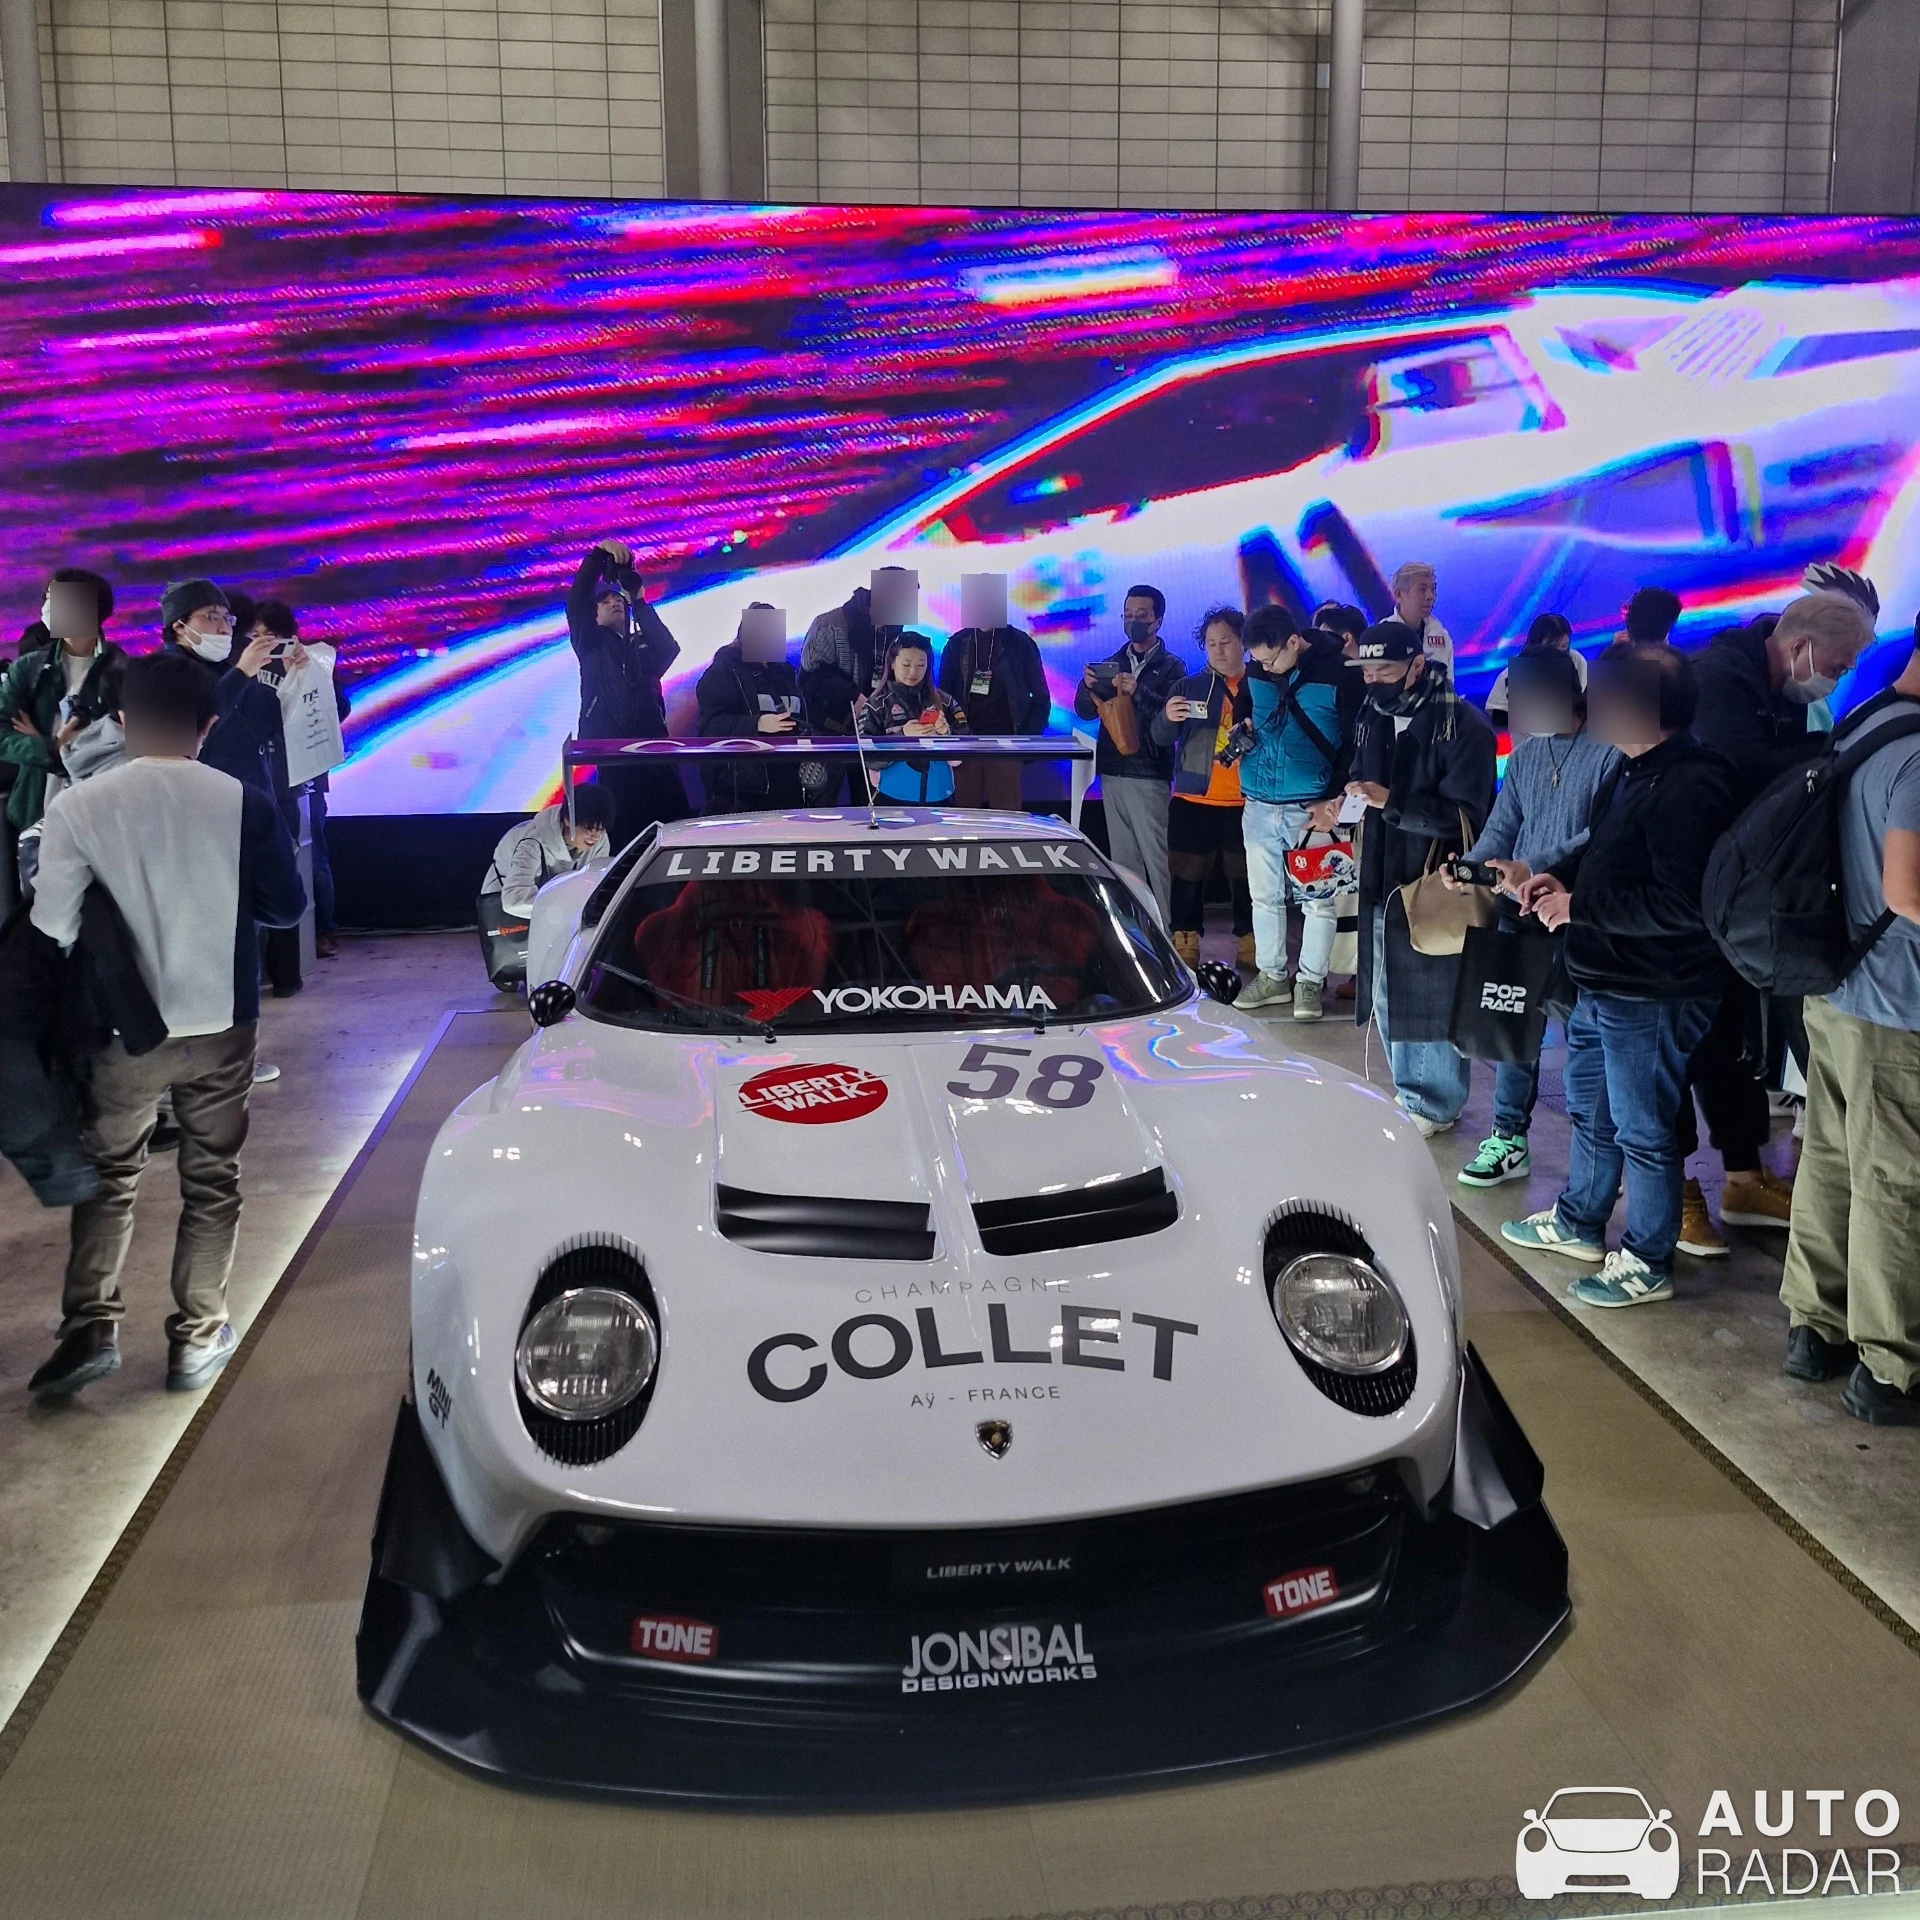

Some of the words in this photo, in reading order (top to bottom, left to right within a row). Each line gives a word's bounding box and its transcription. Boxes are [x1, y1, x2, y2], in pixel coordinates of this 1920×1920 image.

[667, 848, 917, 876] LIBERTY
[926, 845, 1080, 868] WALK
[812, 985, 1057, 1013] YOKOHAMA
[1482, 982, 1526, 999] POP
[1480, 998, 1525, 1014] RACE
[738, 1069, 876, 1104] LIBERTY
[948, 1044, 1104, 1108] 58
[771, 1083, 870, 1112] WALK
[855, 1277, 1071, 1303] CHAMPAGNE
[747, 1303, 1198, 1403] COLLET
[968, 1386, 1061, 1402] FRANCE
[926, 1563, 1010, 1579] LIBERTY
[1014, 1557, 1072, 1573] WALK
[1267, 1570, 1333, 1612] TONE
[639, 1620, 713, 1656] TONE
[902, 1623, 1094, 1676] JONSIBAL
[902, 1664, 1098, 1694] DESIGNWORKS
